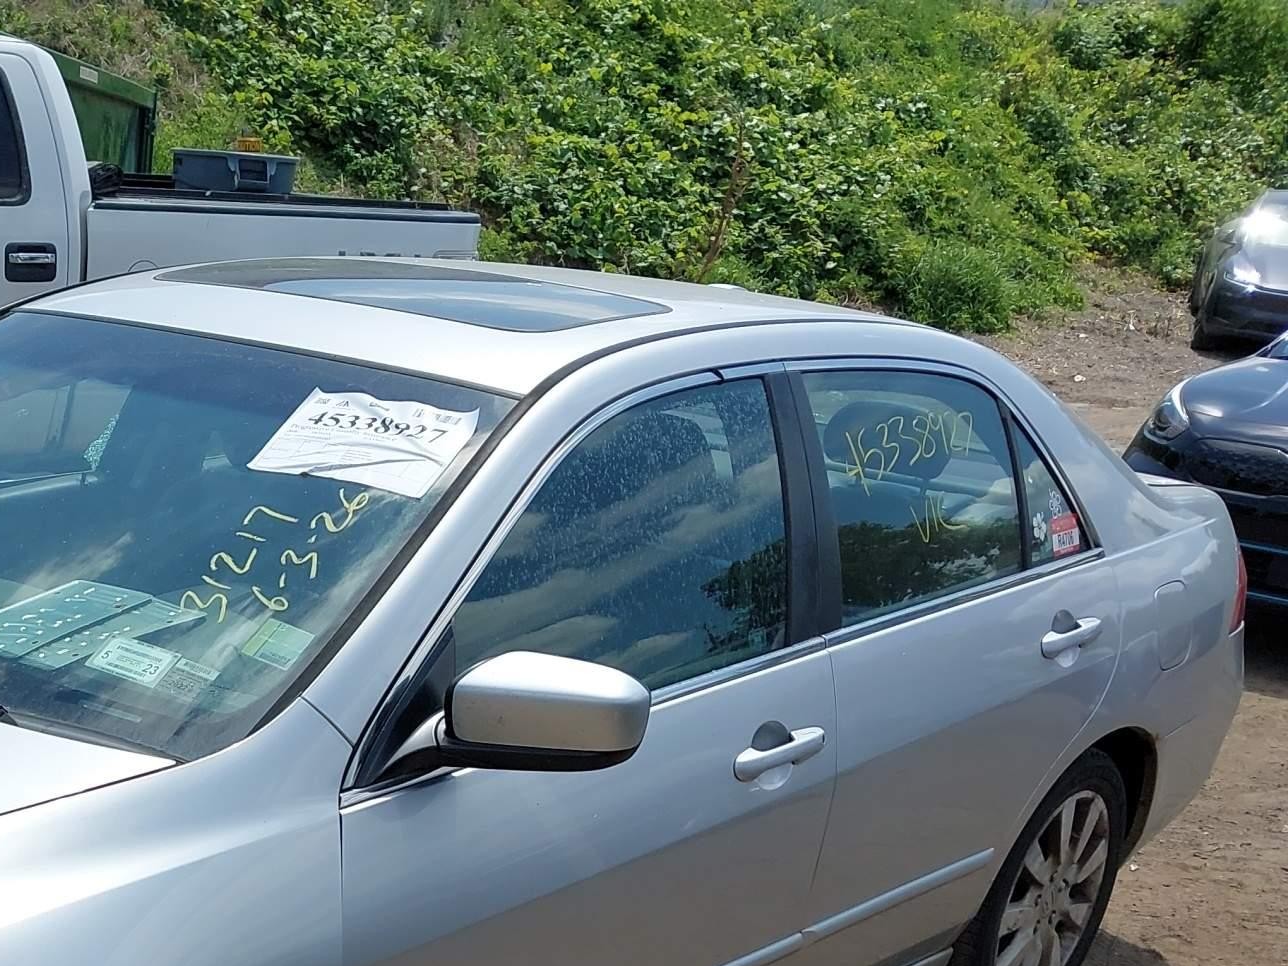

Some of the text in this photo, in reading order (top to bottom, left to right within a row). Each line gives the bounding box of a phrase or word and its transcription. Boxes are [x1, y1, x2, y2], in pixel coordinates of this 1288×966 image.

[308, 411, 449, 444] 45338927
[845, 410, 973, 497] 45338927
[179, 505, 299, 624] 31217
[251, 487, 370, 612] 6-3-26
[100, 649, 113, 660] 5
[141, 663, 160, 676] 23
